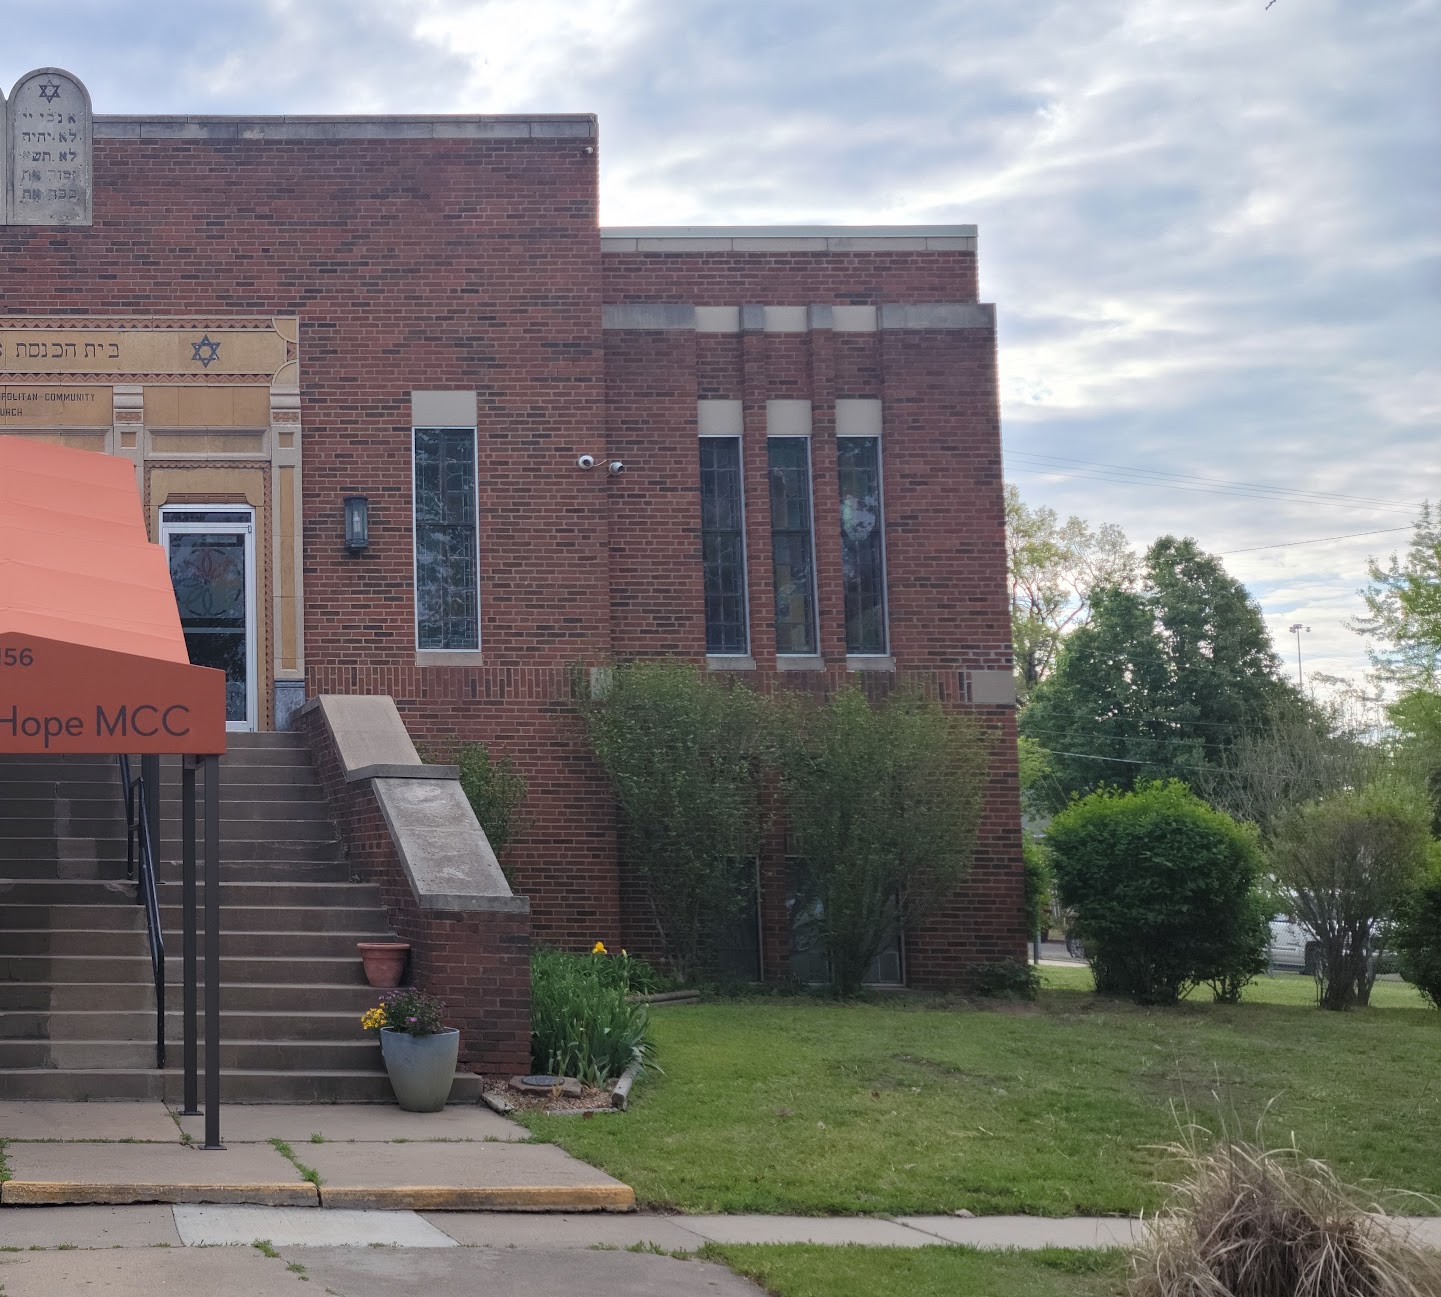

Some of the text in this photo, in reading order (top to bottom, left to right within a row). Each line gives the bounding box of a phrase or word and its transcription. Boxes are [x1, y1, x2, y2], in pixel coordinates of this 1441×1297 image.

[58, 128, 77, 143] לא
[58, 147, 77, 162] לא
[44, 393, 95, 402] COMMUNITY
[95, 704, 191, 737] MCC
